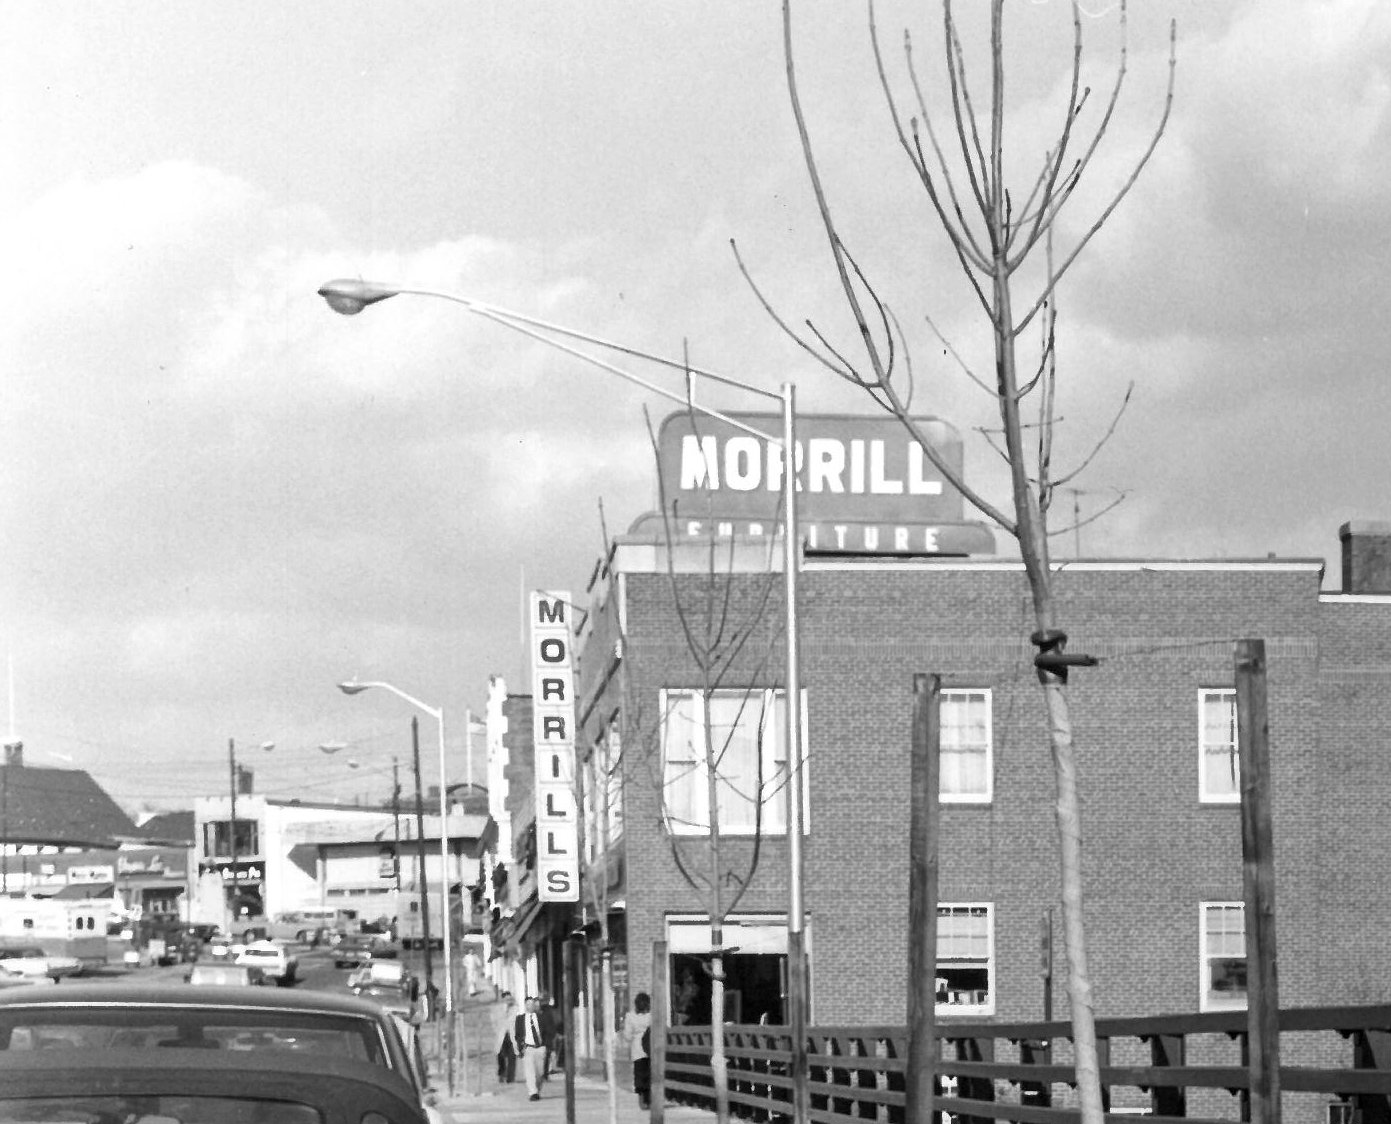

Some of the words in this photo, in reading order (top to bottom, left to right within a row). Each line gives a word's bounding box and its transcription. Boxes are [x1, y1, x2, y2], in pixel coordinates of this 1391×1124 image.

[680, 435, 942, 495] MORRILL
[687, 521, 940, 552] FURITURE
[538, 600, 571, 893] MORRILLS
